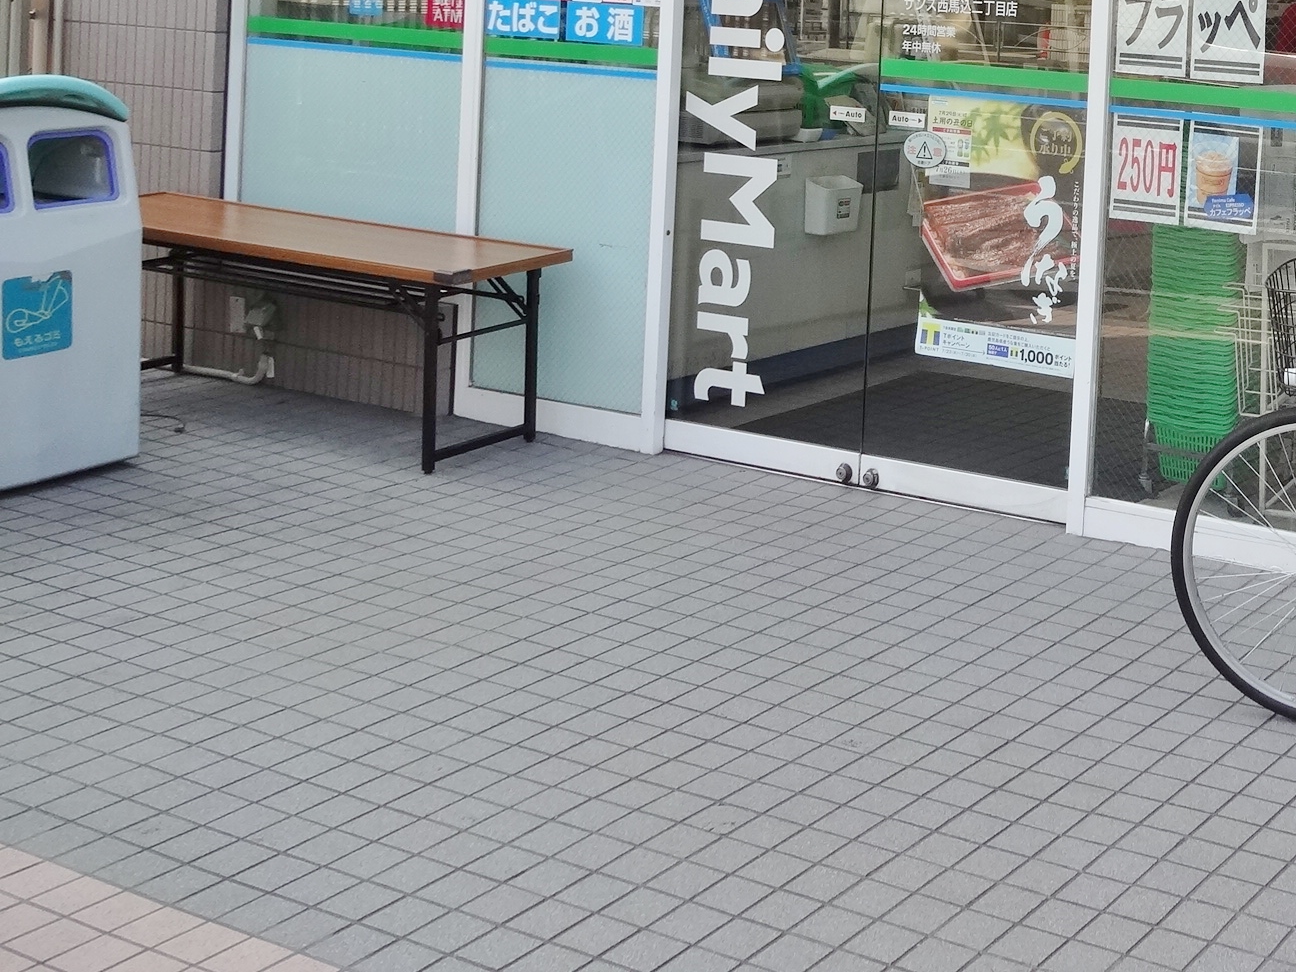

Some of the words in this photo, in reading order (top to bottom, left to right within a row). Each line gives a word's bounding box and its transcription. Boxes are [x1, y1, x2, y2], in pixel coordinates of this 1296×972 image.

[433, 9, 463, 24] ATM
[487, 0, 559, 35] たばこ
[574, 6, 635, 42] お酒
[902, 24, 956, 38] 24時間営業
[901, 40, 942, 54] 年中無休
[845, 110, 862, 119] Auto
[891, 114, 910, 124] Auto
[932, 116, 973, 128] 土用の丑の日
[1117, 137, 1177, 198] 250円
[1210, 207, 1251, 217] カフェフラッペ
[1021, 176, 1068, 325] うなぎ
[1020, 348, 1054, 366] 1,000
[1054, 354, 1072, 362] ポイント
